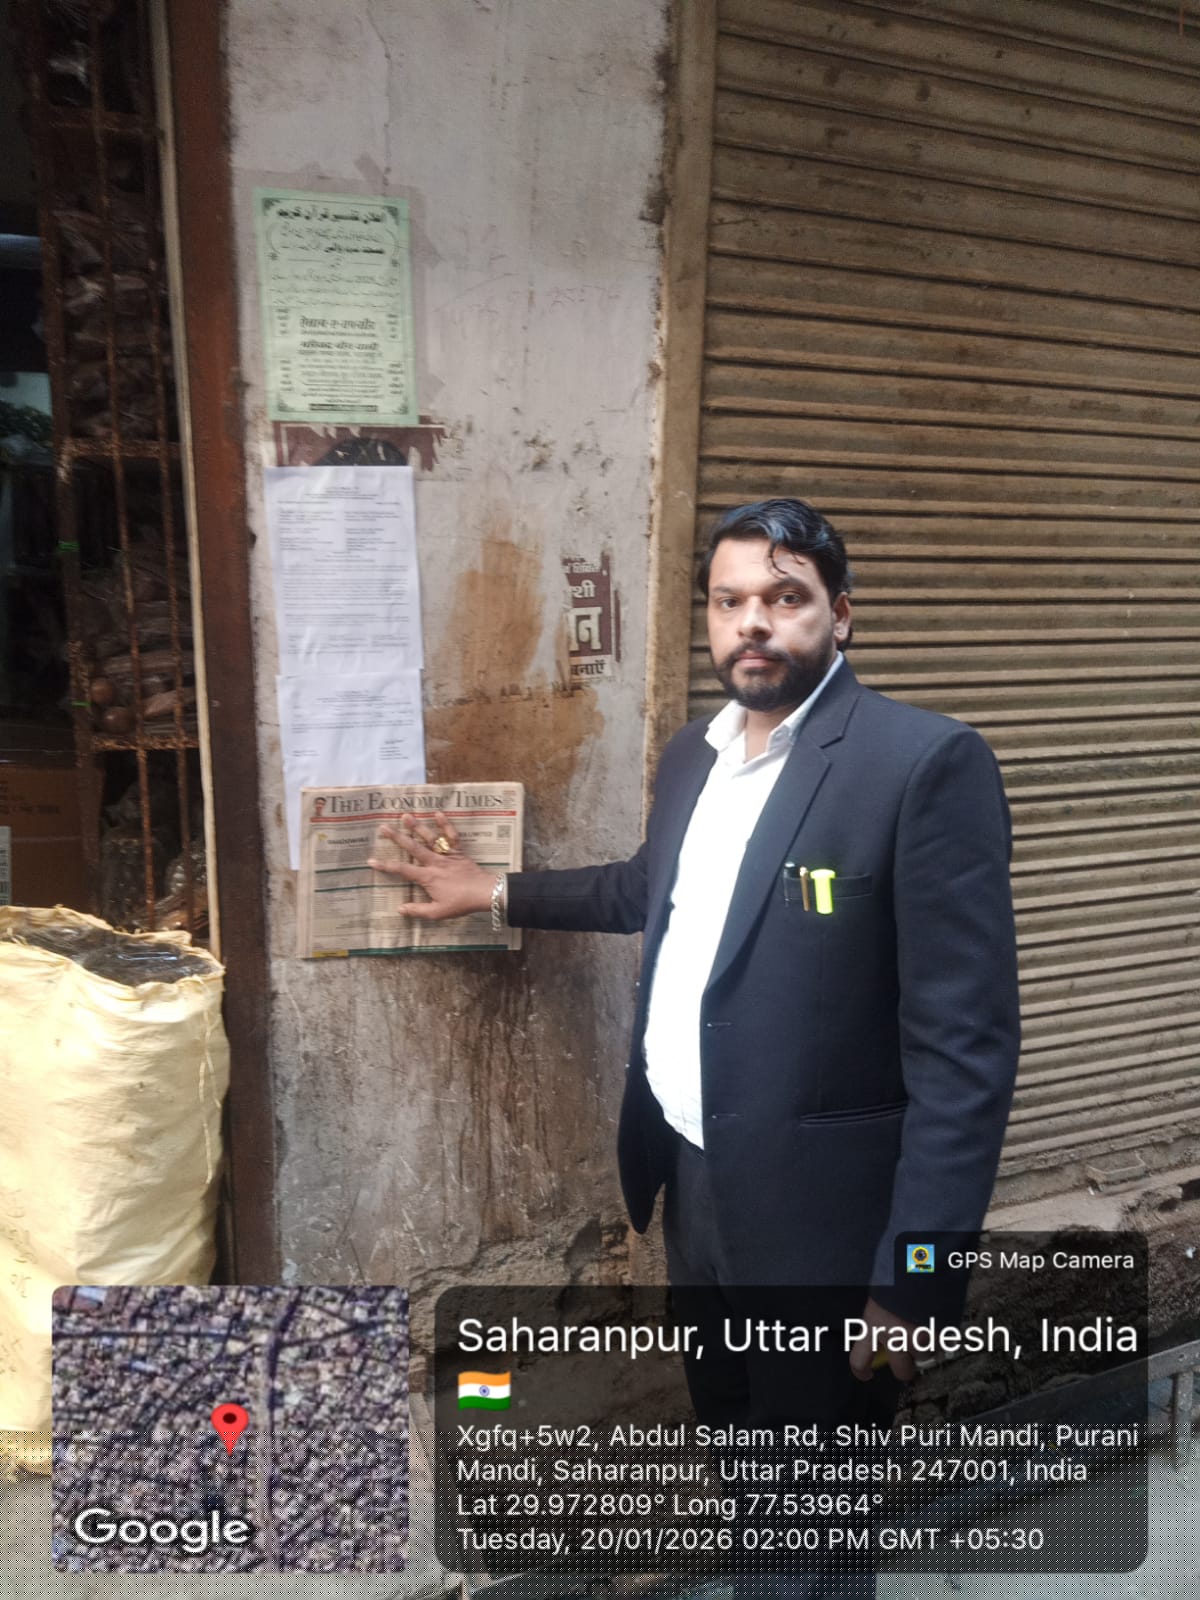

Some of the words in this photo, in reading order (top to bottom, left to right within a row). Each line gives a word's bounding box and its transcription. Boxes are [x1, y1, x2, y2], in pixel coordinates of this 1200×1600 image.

[568, 579, 596, 598] शी
[567, 606, 602, 651] ान
[326, 795, 363, 813] THE
[368, 792, 449, 810] ECONOMIC
[452, 790, 502, 808] TIMES
